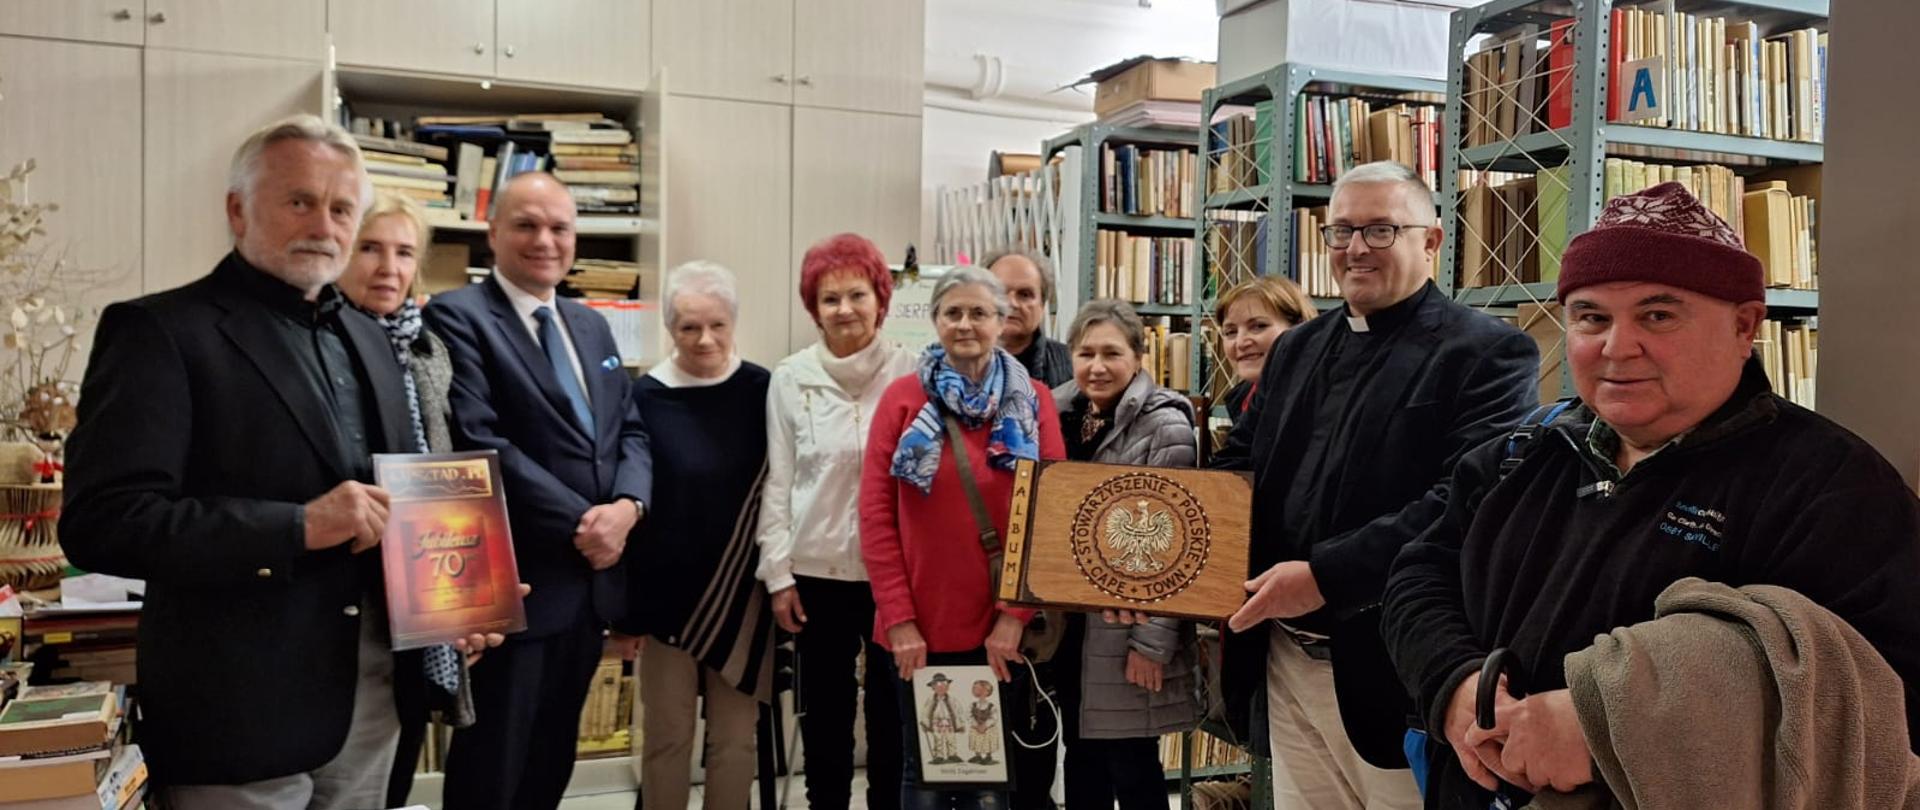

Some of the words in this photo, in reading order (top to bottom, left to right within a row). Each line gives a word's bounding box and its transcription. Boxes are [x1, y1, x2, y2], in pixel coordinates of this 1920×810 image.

[1628, 68, 1656, 112] A
[1006, 486, 1026, 573] ALBUM
[1077, 479, 1168, 556] STOWARZYSZENIE
[1178, 499, 1204, 562] POLSKIE
[429, 551, 466, 578] 70
[1091, 566, 1126, 594] CAPE
[1142, 568, 1187, 596] TOWN
